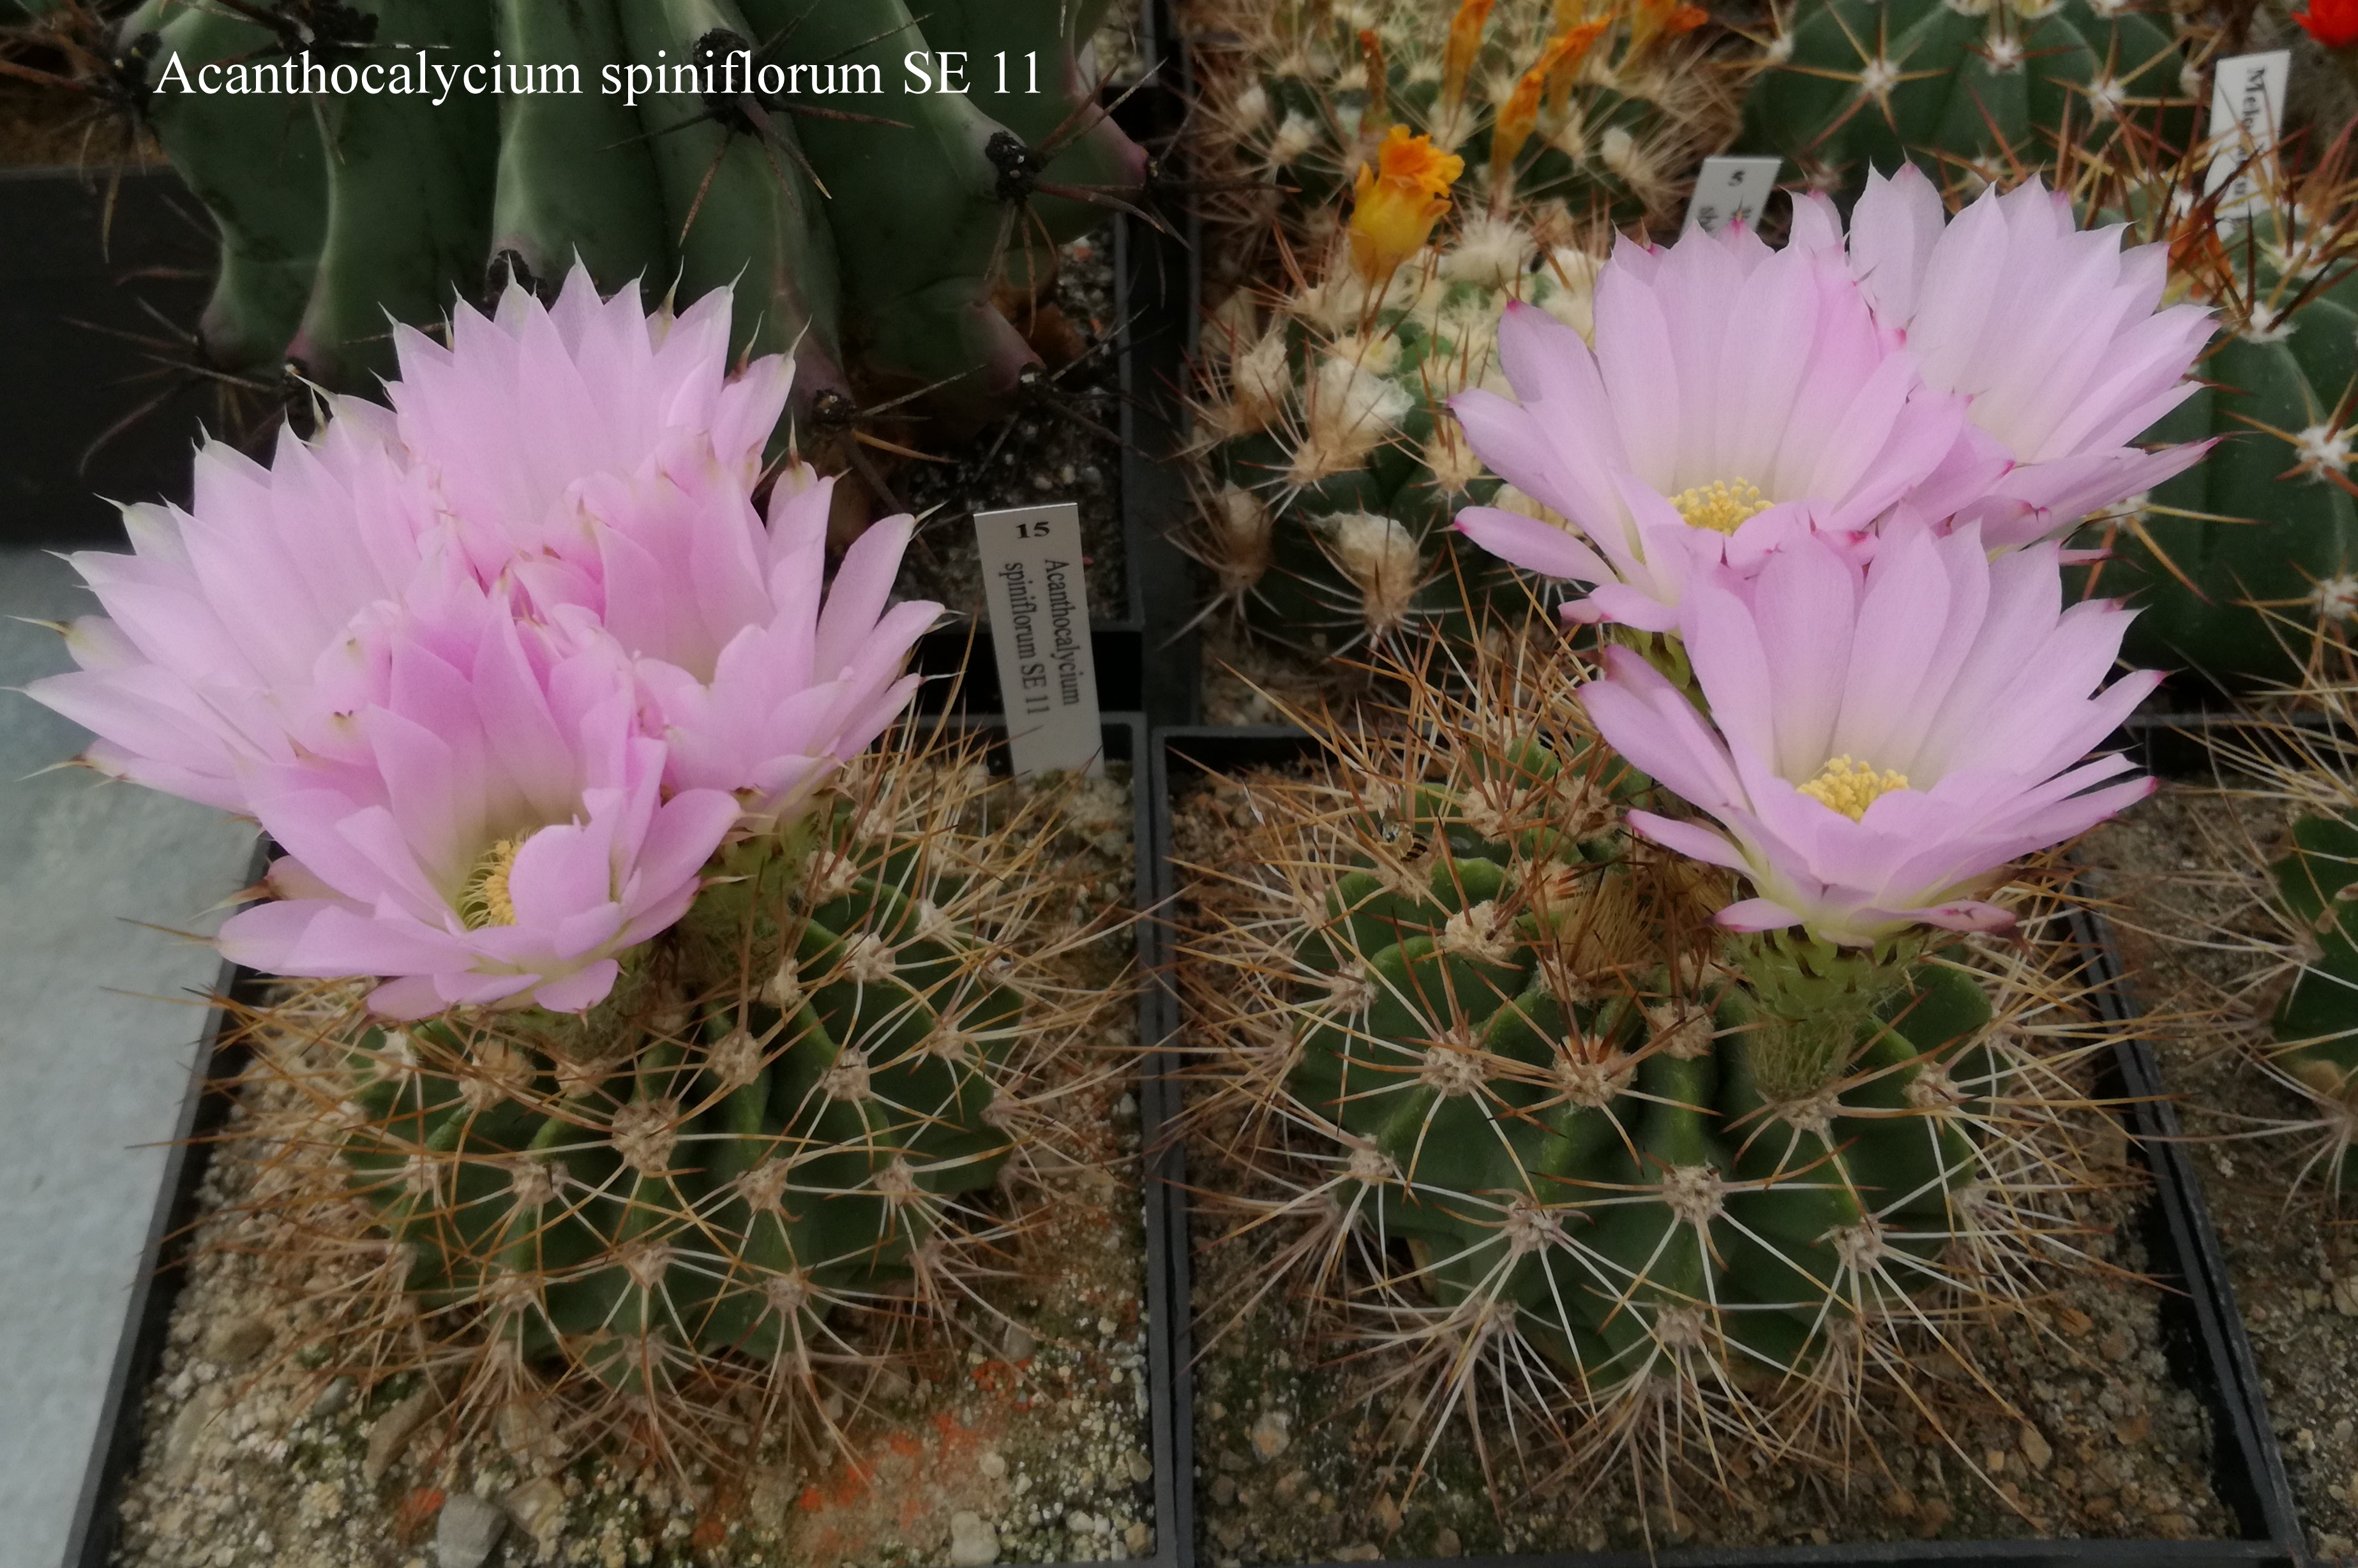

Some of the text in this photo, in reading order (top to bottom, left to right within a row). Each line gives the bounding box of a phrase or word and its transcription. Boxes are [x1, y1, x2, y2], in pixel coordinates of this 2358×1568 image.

[1015, 521, 1051, 539] 15
[999, 562, 1051, 715] spiniflorum SE 11
[1044, 558, 1084, 706] Acanthocalycium
